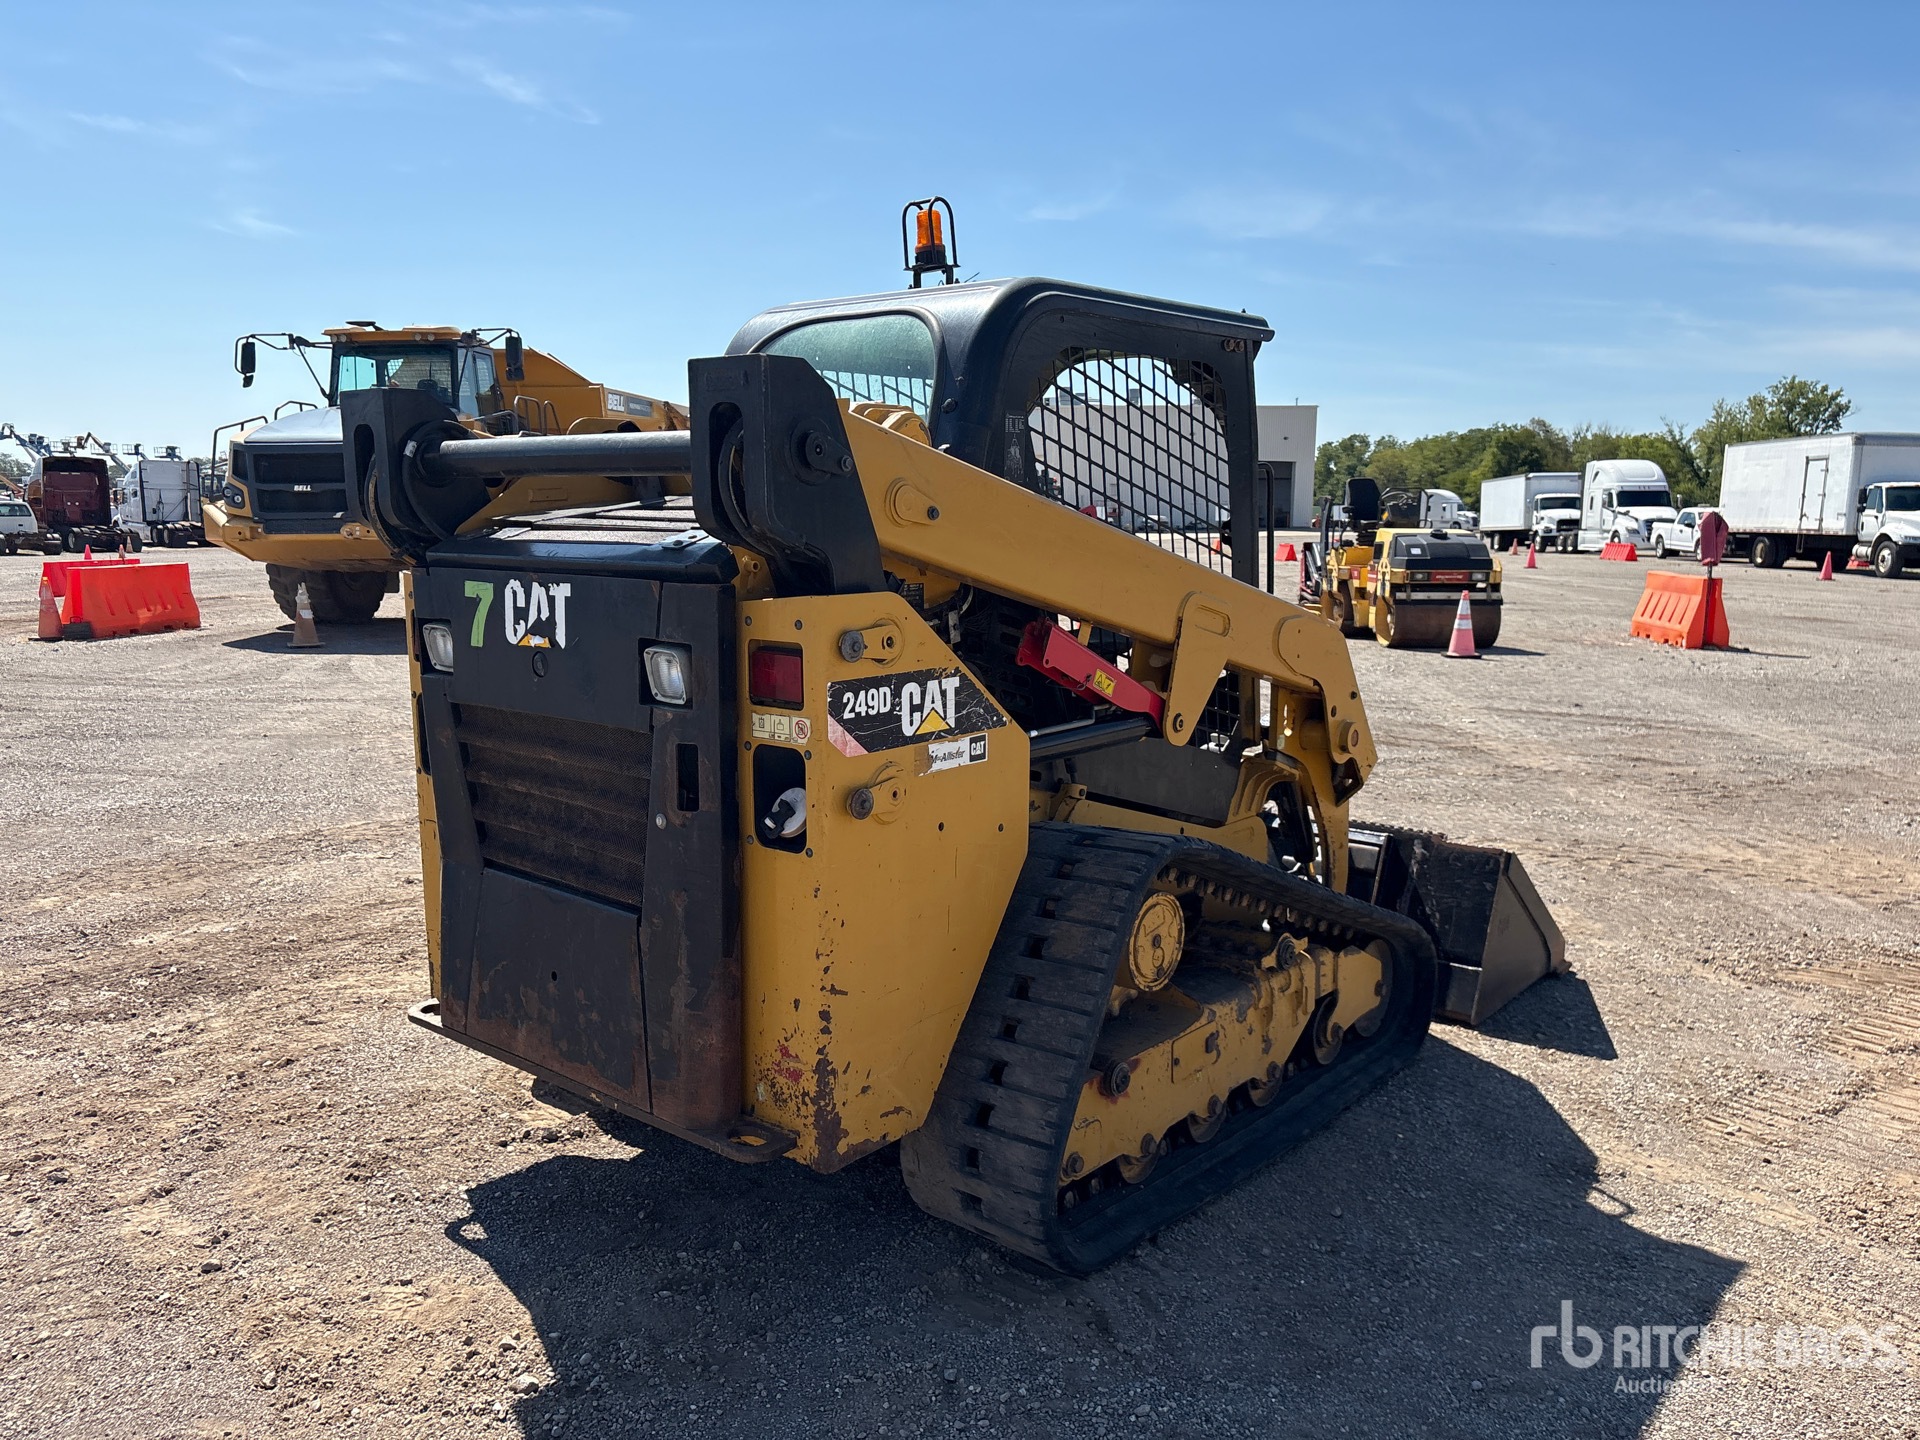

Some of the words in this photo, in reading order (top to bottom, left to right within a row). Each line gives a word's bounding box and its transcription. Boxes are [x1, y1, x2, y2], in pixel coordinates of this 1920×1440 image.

[607, 392, 625, 412] BELL
[293, 484, 312, 492] BELL
[464, 580, 494, 648] 7
[504, 579, 571, 650] CAT
[843, 686, 891, 719] 249D
[901, 677, 960, 737] CAT
[971, 741, 986, 756] CAT
